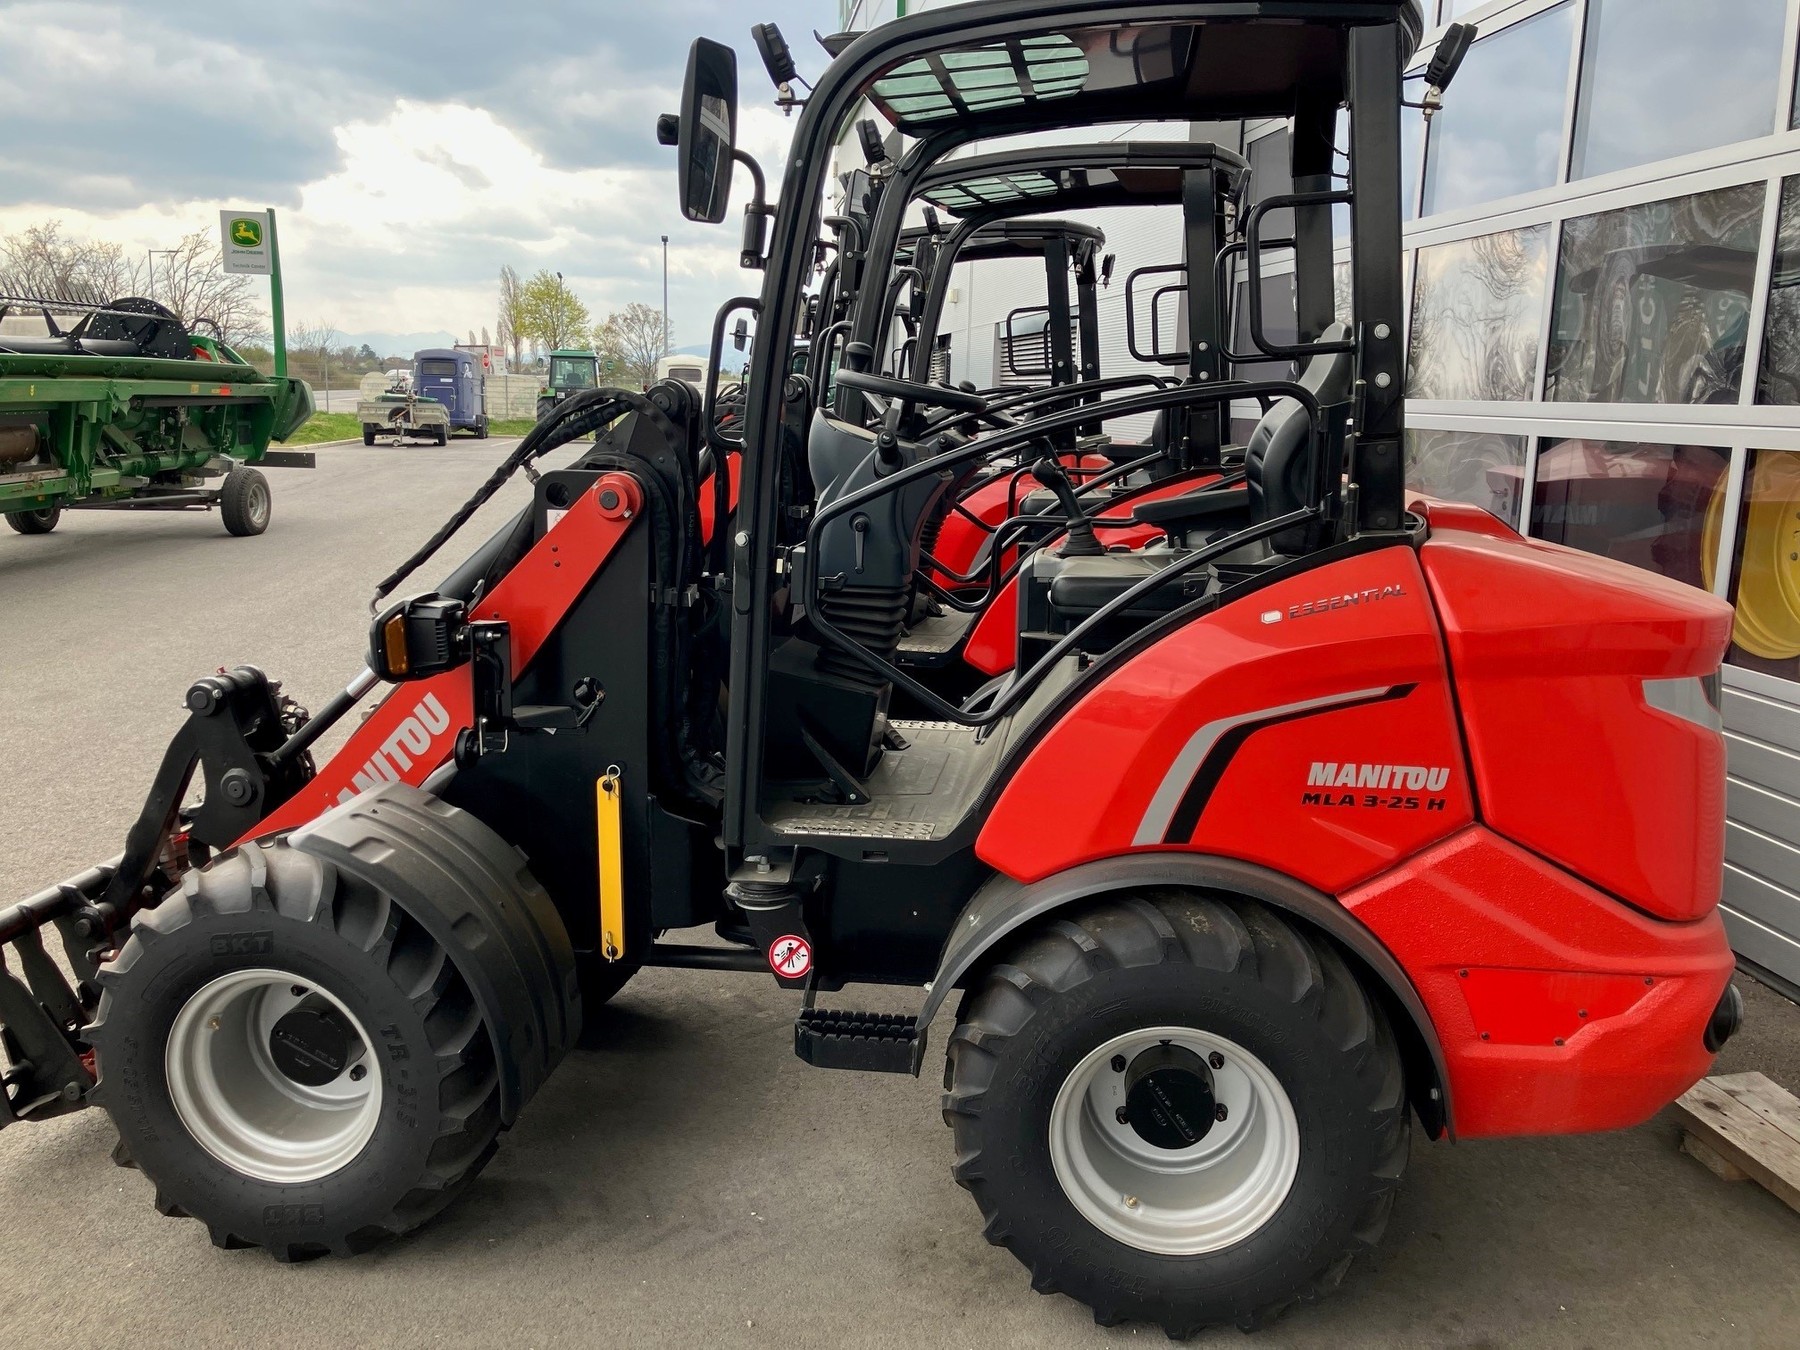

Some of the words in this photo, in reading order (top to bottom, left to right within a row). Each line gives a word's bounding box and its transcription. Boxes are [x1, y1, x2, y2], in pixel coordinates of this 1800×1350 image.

[1289, 584, 1407, 619] ESSENTIAL
[1307, 762, 1451, 792] MANITOU
[1302, 792, 1355, 808] MLA
[1362, 794, 1421, 811] 3-25
[1426, 797, 1447, 811] H
[212, 934, 271, 955] BKT
